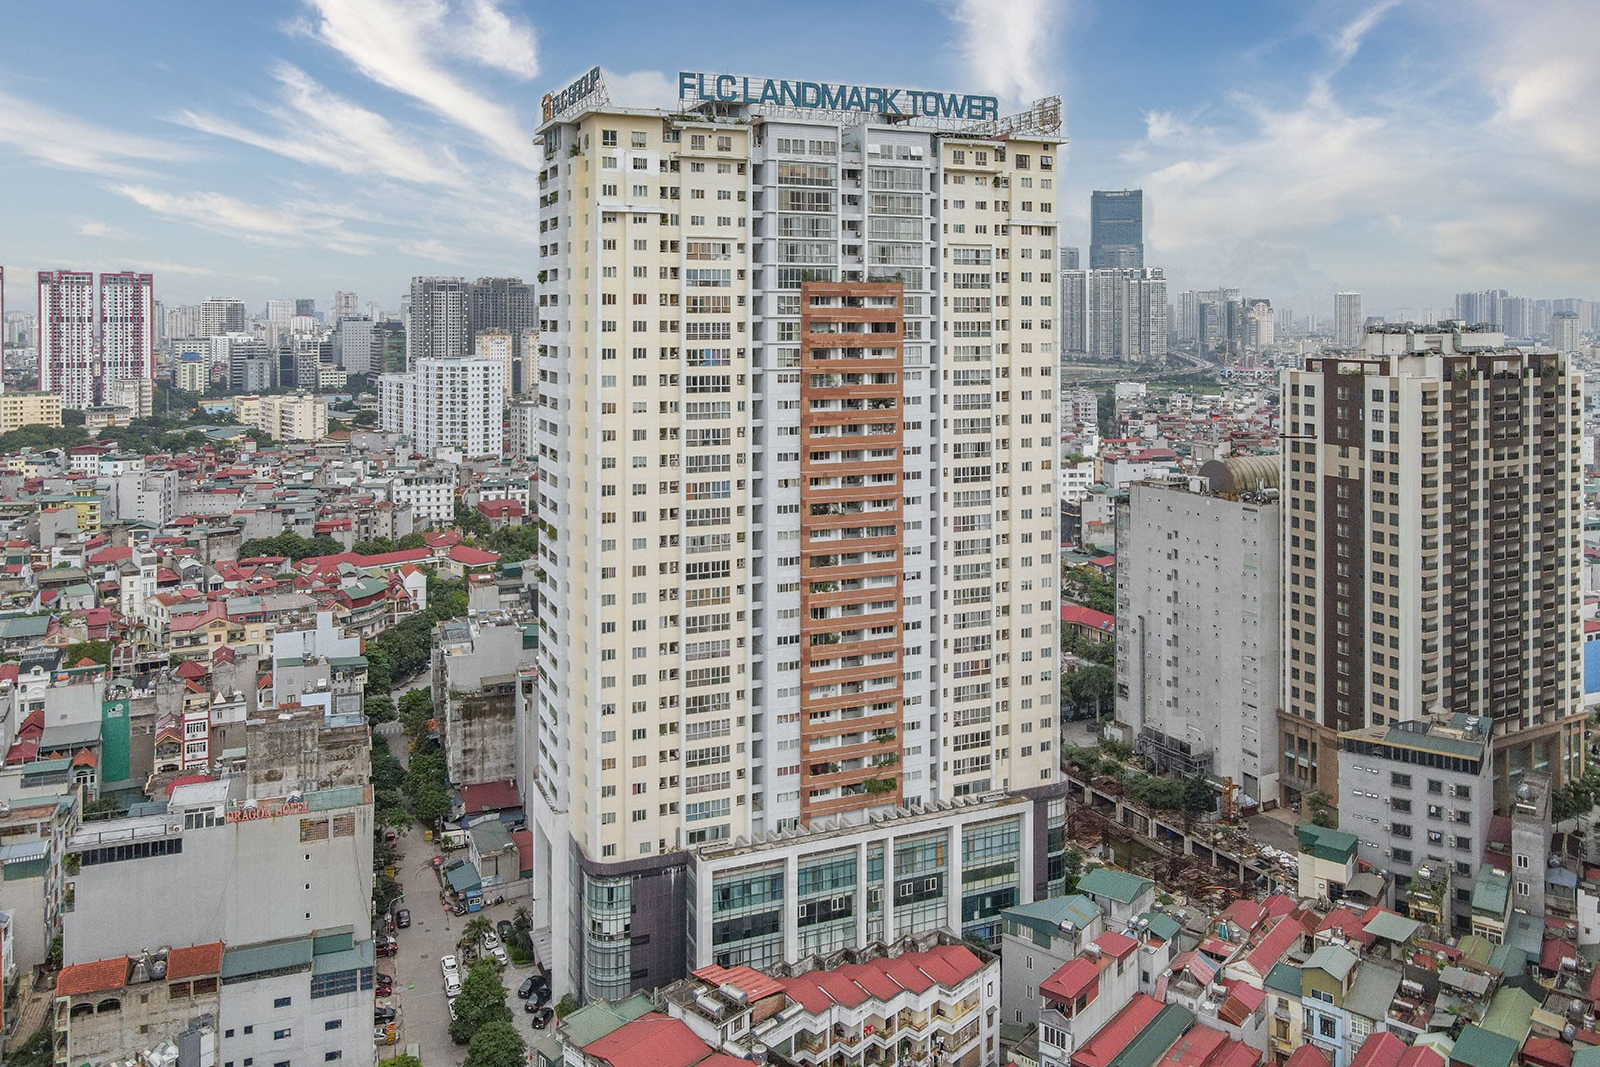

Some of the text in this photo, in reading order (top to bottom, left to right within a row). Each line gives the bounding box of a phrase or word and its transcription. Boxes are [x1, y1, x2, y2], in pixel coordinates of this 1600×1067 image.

[552, 66, 600, 118] FLC GROUP
[680, 72, 998, 121] FLC LANDMARK TOWER
[226, 801, 310, 824] DRAGON HOTEL
